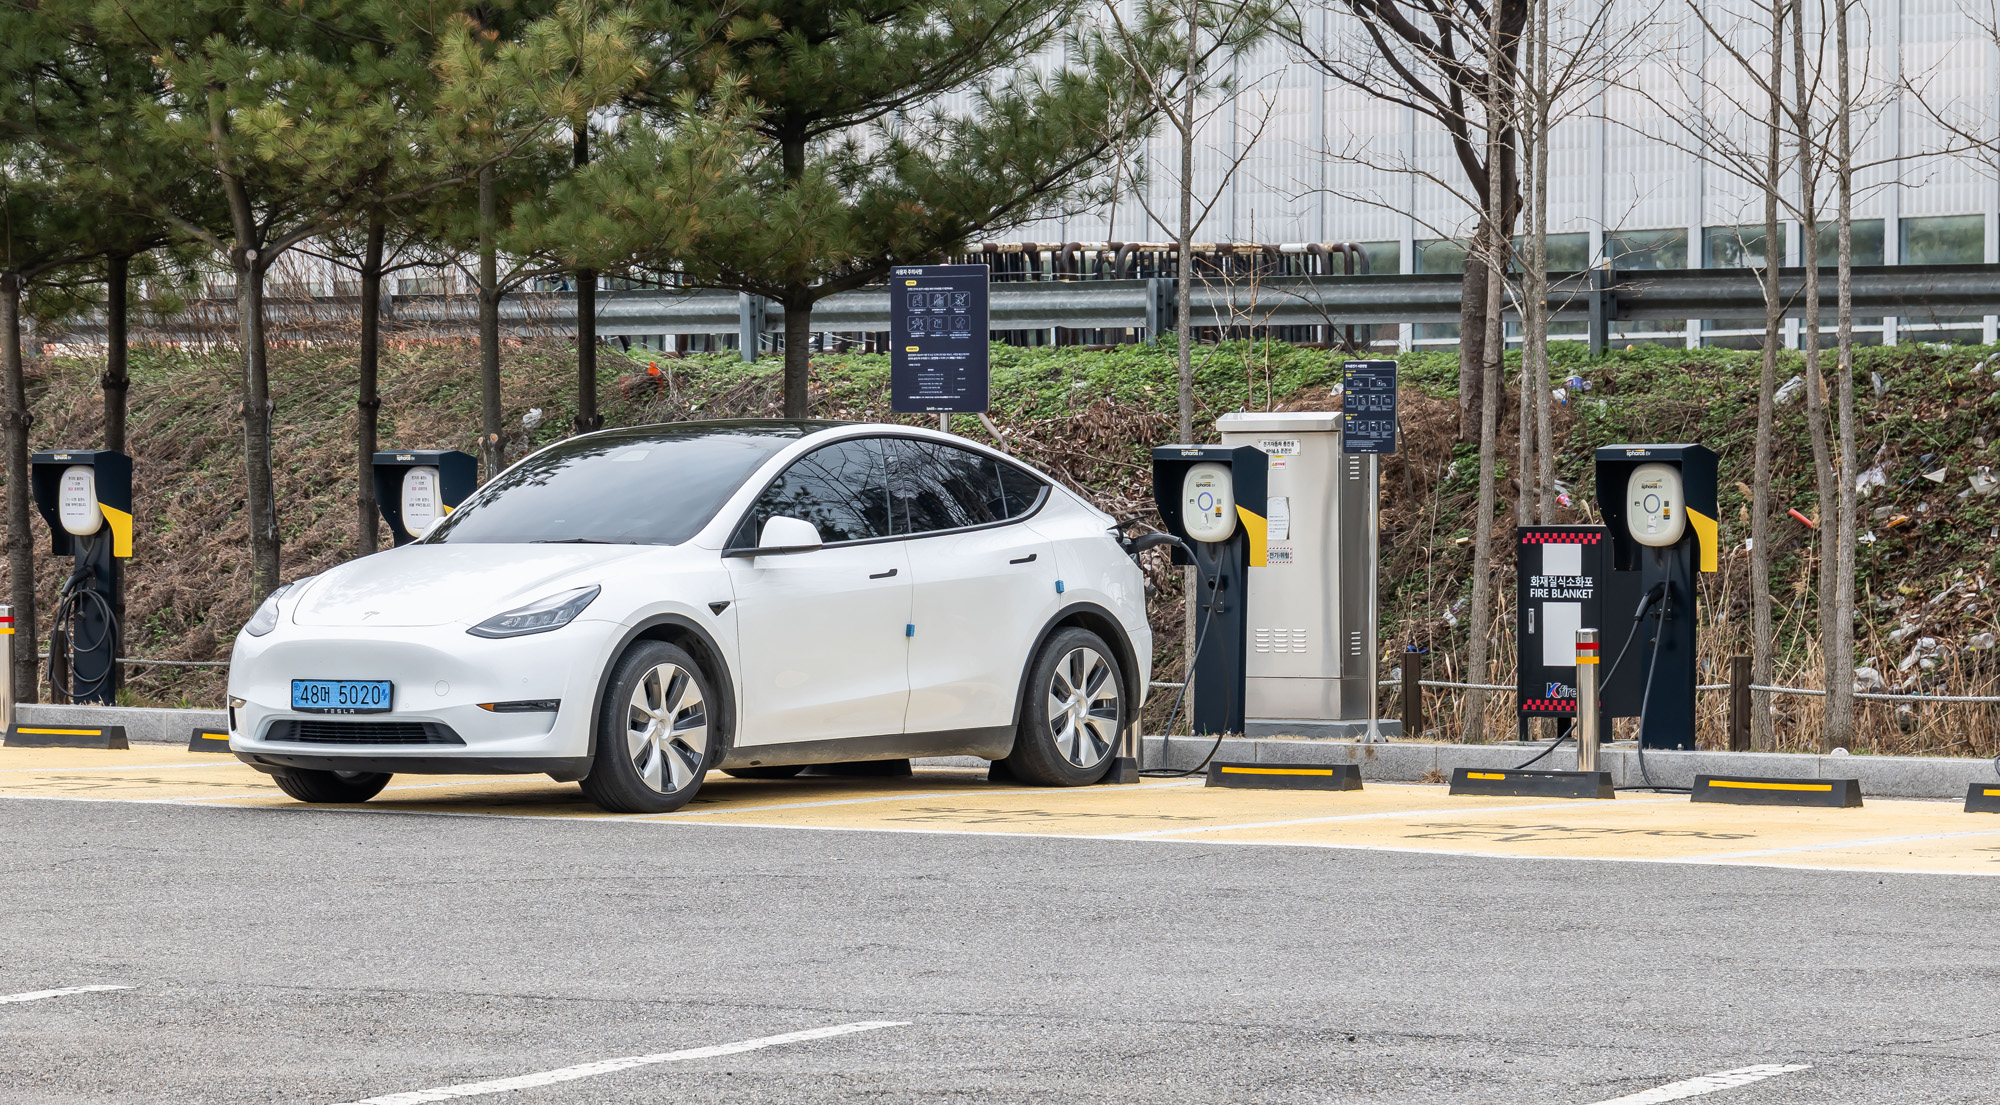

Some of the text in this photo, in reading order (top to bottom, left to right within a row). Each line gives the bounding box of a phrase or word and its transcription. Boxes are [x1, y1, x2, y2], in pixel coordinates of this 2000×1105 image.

[1530, 576, 1593, 587] 화재질식소화포
[1530, 589, 1593, 599] FIRE BLANKET
[300, 684, 381, 705] 48머 5020
